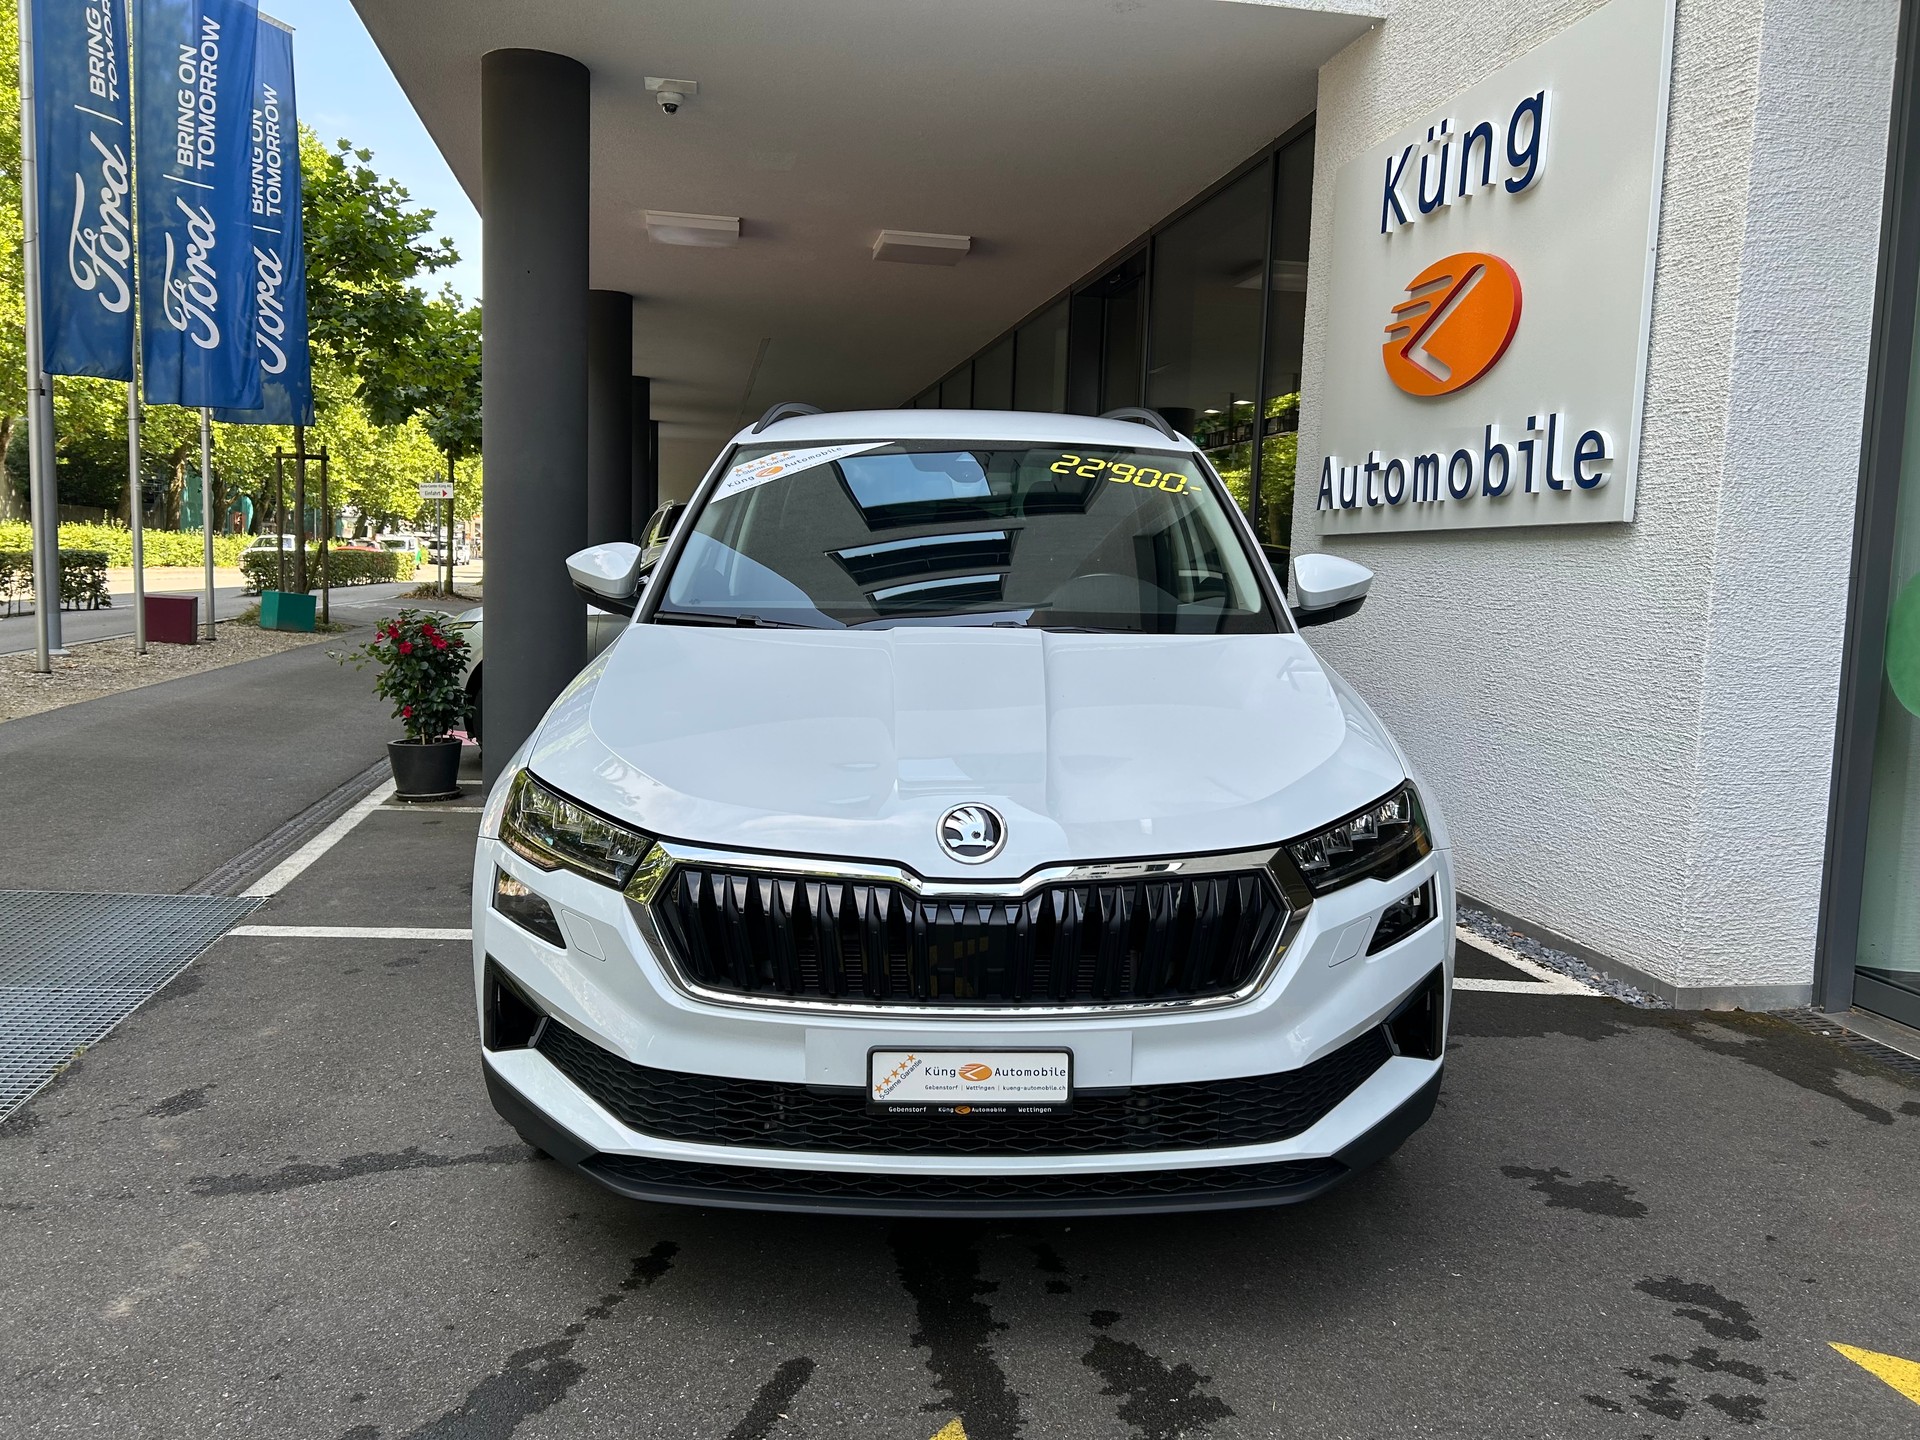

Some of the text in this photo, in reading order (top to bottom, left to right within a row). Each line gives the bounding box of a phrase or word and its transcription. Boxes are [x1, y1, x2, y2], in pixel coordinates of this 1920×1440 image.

[86, 7, 106, 98] BRING
[102, 0, 120, 102] TOMOR
[197, 15, 221, 171] TOMORROW
[176, 44, 197, 168] BRING ON
[262, 82, 282, 217] TOMORROW
[1381, 89, 1552, 234] Küng
[69, 131, 131, 313] Ford
[163, 196, 220, 349] Ford
[727, 447, 843, 488] Küng Automobile
[1050, 454, 1202, 496] 22'900.-
[1317, 412, 1613, 511] Automobile
[879, 1058, 923, 1100] 5-Sterne Garantie
[925, 1066, 1066, 1078] Küng Automobile
[938, 1106, 954, 1114] Küng
[1018, 1106, 1052, 1114] Wettingen
